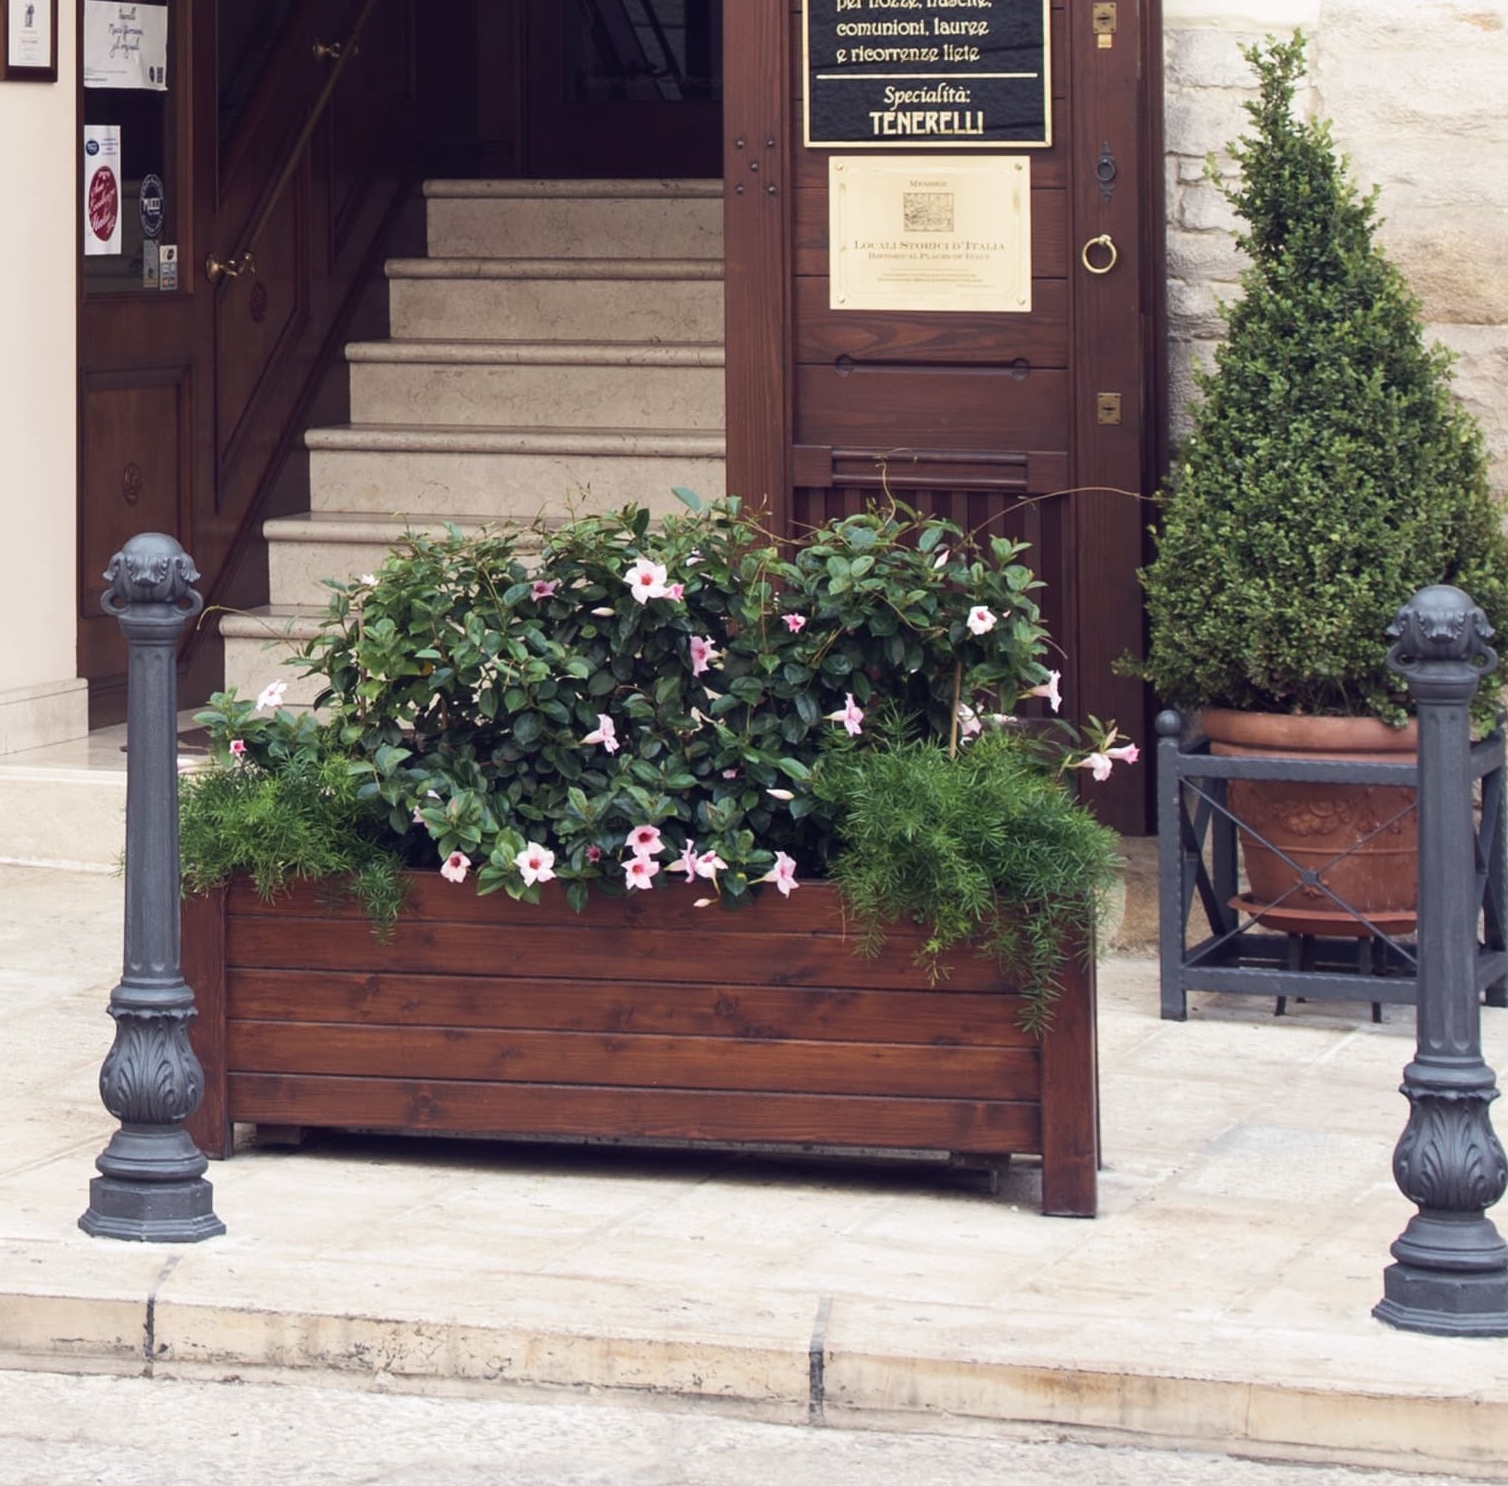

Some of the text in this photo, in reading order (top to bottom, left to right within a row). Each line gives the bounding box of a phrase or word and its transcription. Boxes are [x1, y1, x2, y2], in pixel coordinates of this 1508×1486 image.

[933, 17, 990, 36] lauree
[836, 44, 980, 63] e ricorrenze liete
[869, 111, 984, 135] TENERELLI
